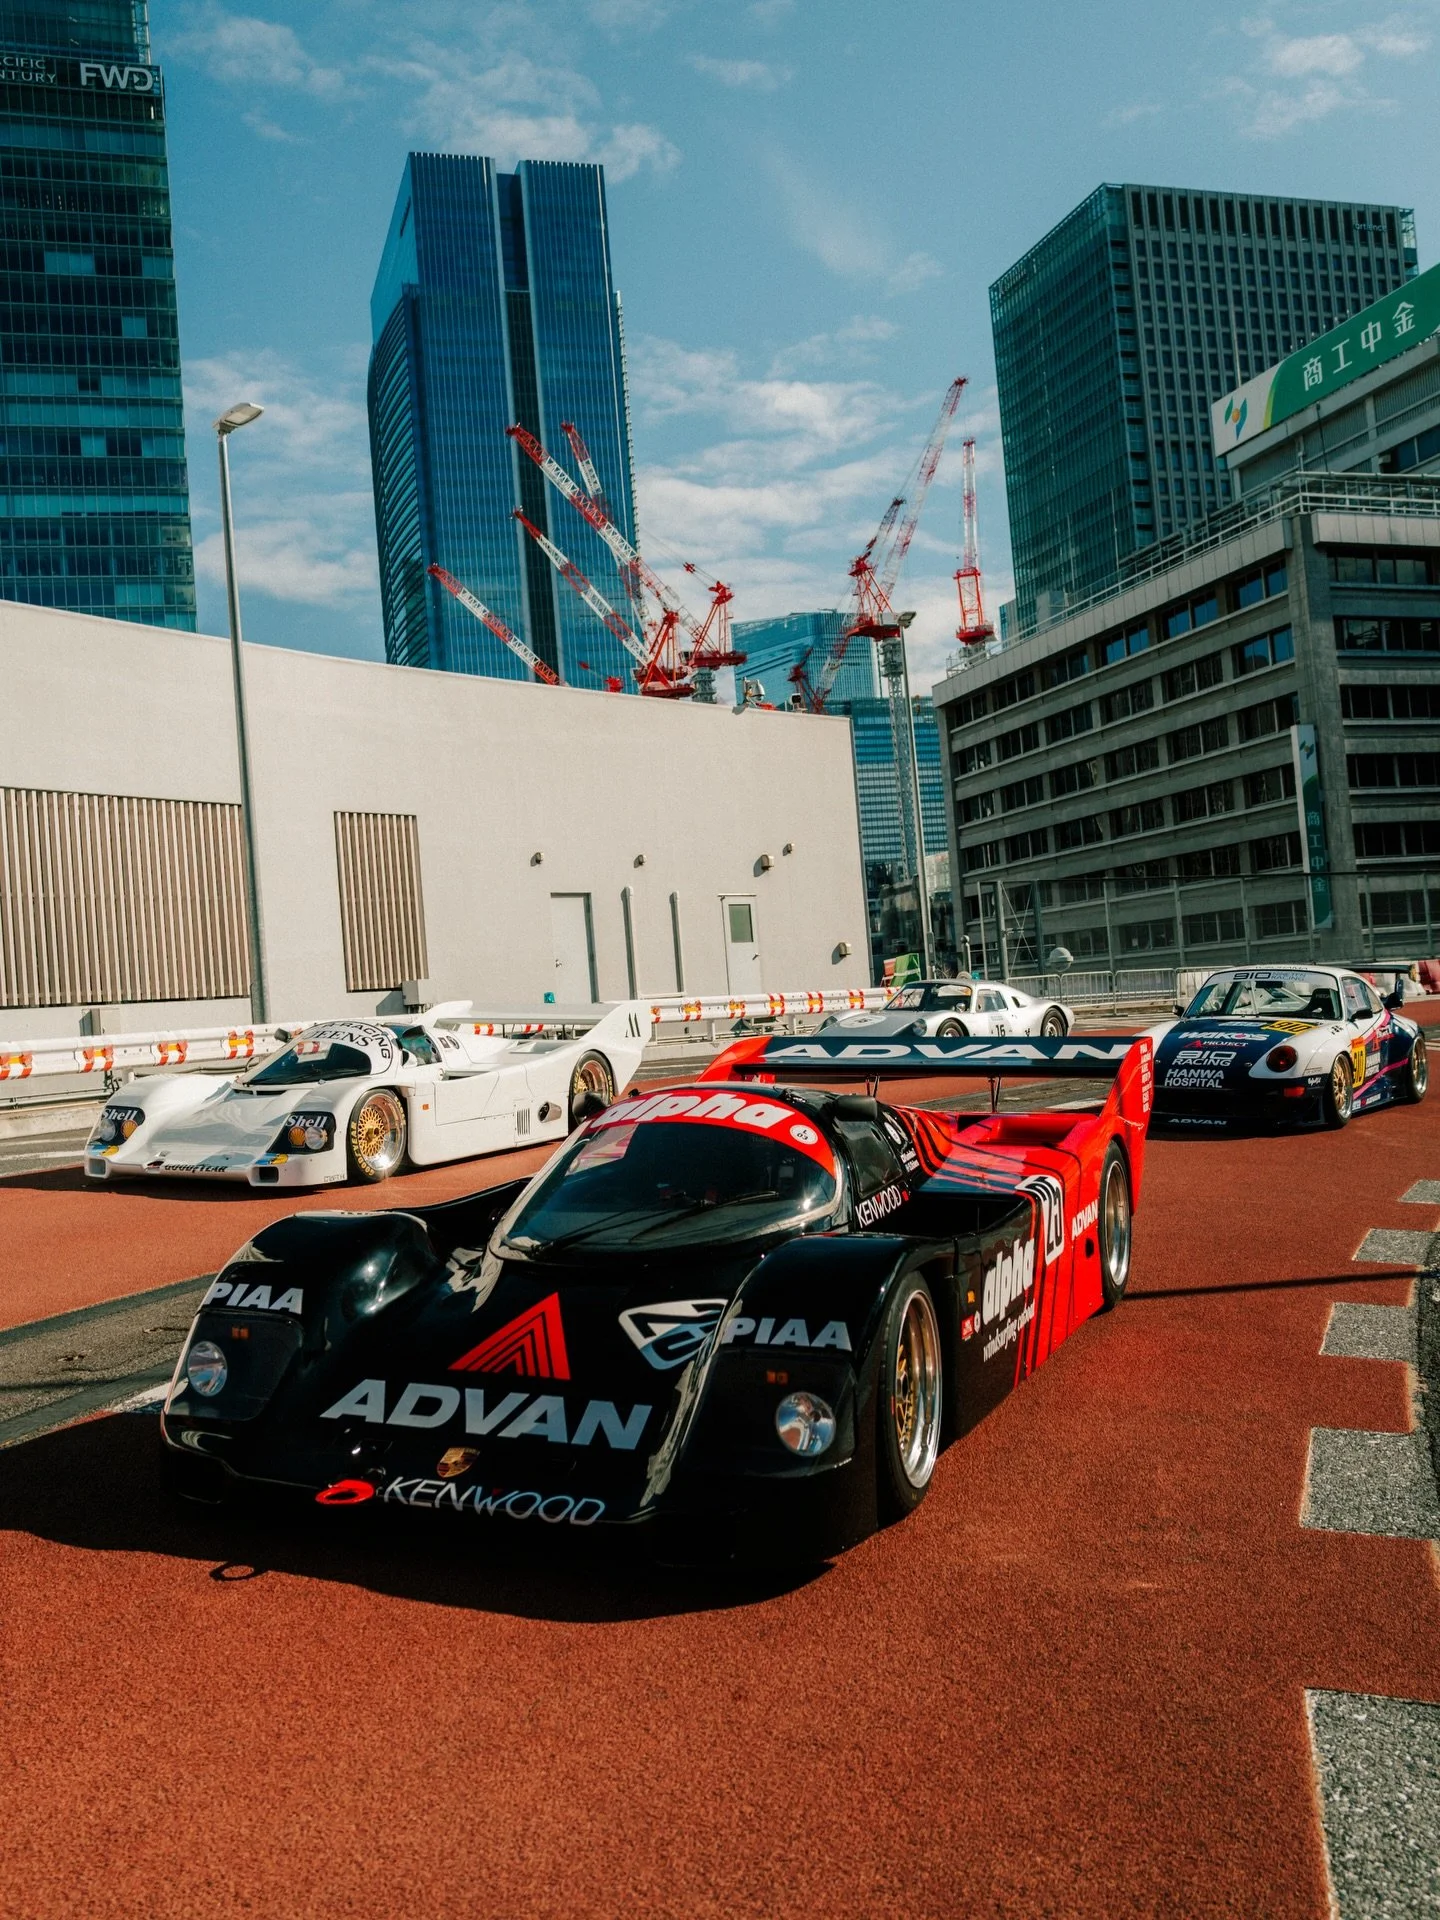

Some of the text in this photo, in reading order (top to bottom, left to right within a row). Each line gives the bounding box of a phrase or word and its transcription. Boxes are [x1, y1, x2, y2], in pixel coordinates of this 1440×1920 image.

[0, 57, 46, 70] CIFIC
[80, 62, 153, 91] FWD
[1302, 301, 1416, 392] 商工中金
[1307, 811, 1326, 892] 商工中金
[1233, 972, 1271, 980] 910
[1268, 1021, 1311, 1032] 910
[340, 1023, 391, 1060] RACING
[762, 1044, 1134, 1060] ADVAN
[1176, 1050, 1237, 1060] 910
[1166, 1068, 1225, 1080] HANWA
[1172, 1058, 1232, 1067] RACING
[1164, 1078, 1223, 1088] HOSPITAL
[102, 1108, 139, 1121] Shell
[286, 1114, 328, 1128] Shell
[590, 1093, 795, 1129] alpha
[1168, 1118, 1229, 1126] ADVAN
[351, 1121, 376, 1176] GOODYEAR
[164, 1164, 228, 1173] GOODYEAR
[855, 1185, 902, 1229] KENWOOD
[1072, 1199, 1098, 1241] ADVAN
[982, 1238, 1035, 1326] alpha
[203, 1281, 304, 1315] PIAA
[720, 1317, 852, 1352] PIAA
[319, 1378, 652, 1450] ADVAN
[383, 1476, 606, 1526] KENWOOD
